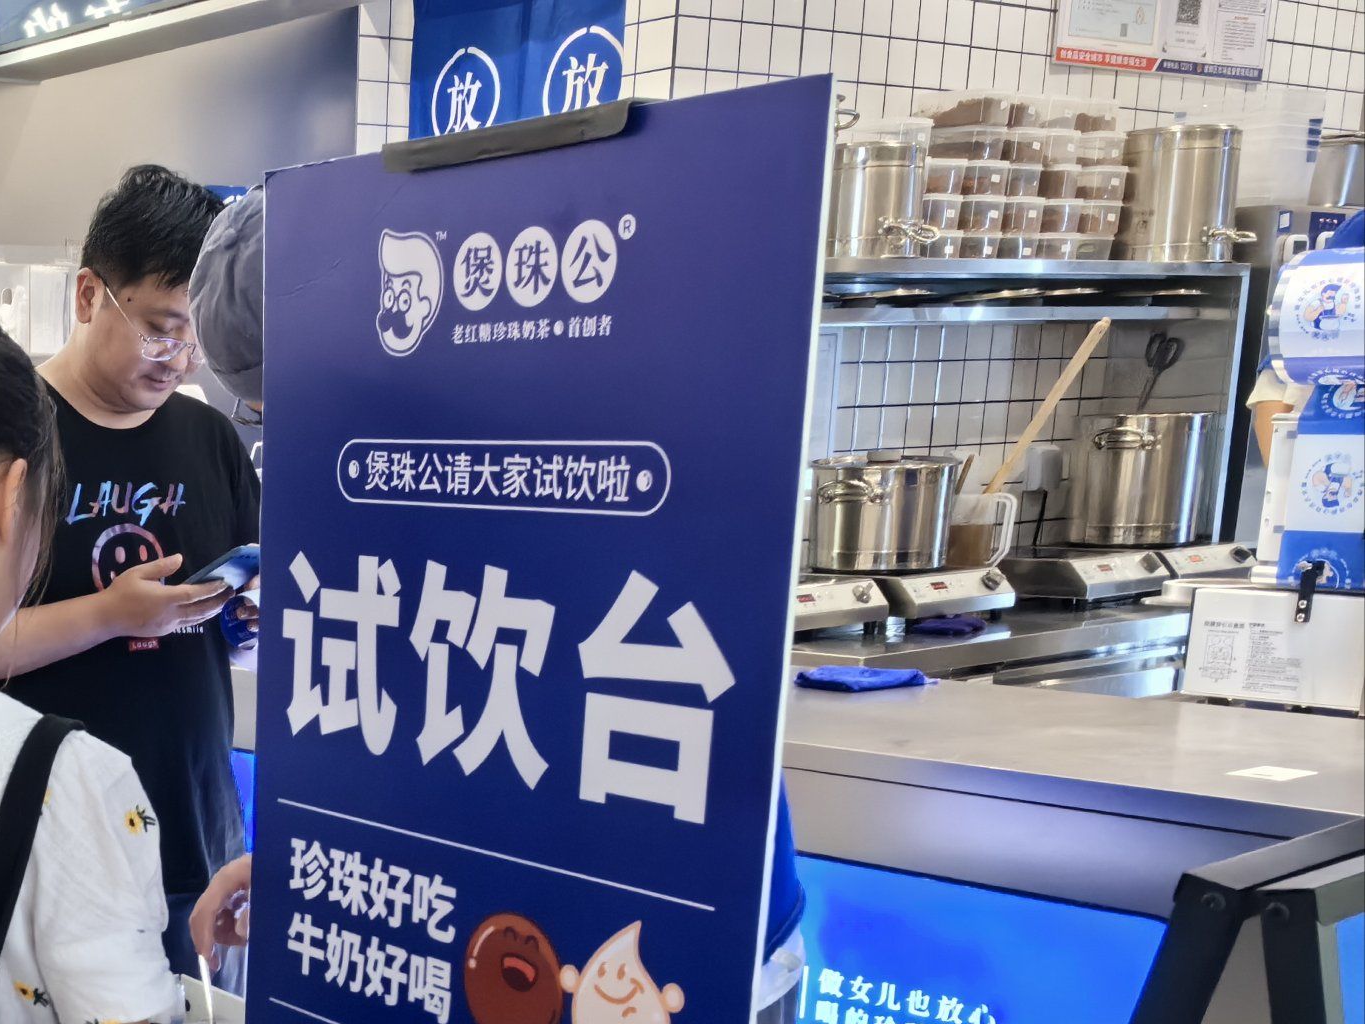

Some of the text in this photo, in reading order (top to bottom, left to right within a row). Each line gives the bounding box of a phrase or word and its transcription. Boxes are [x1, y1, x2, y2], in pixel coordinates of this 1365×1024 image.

[445, 75, 484, 134] 放
[562, 53, 612, 112] 放
[457, 229, 614, 301] 煲珠公
[65, 480, 186, 527] LAUGH
[364, 450, 631, 504] 煲珠公请大家试饮啦
[282, 550, 736, 825] 试饮台
[289, 838, 457, 943] 珍珠好吃
